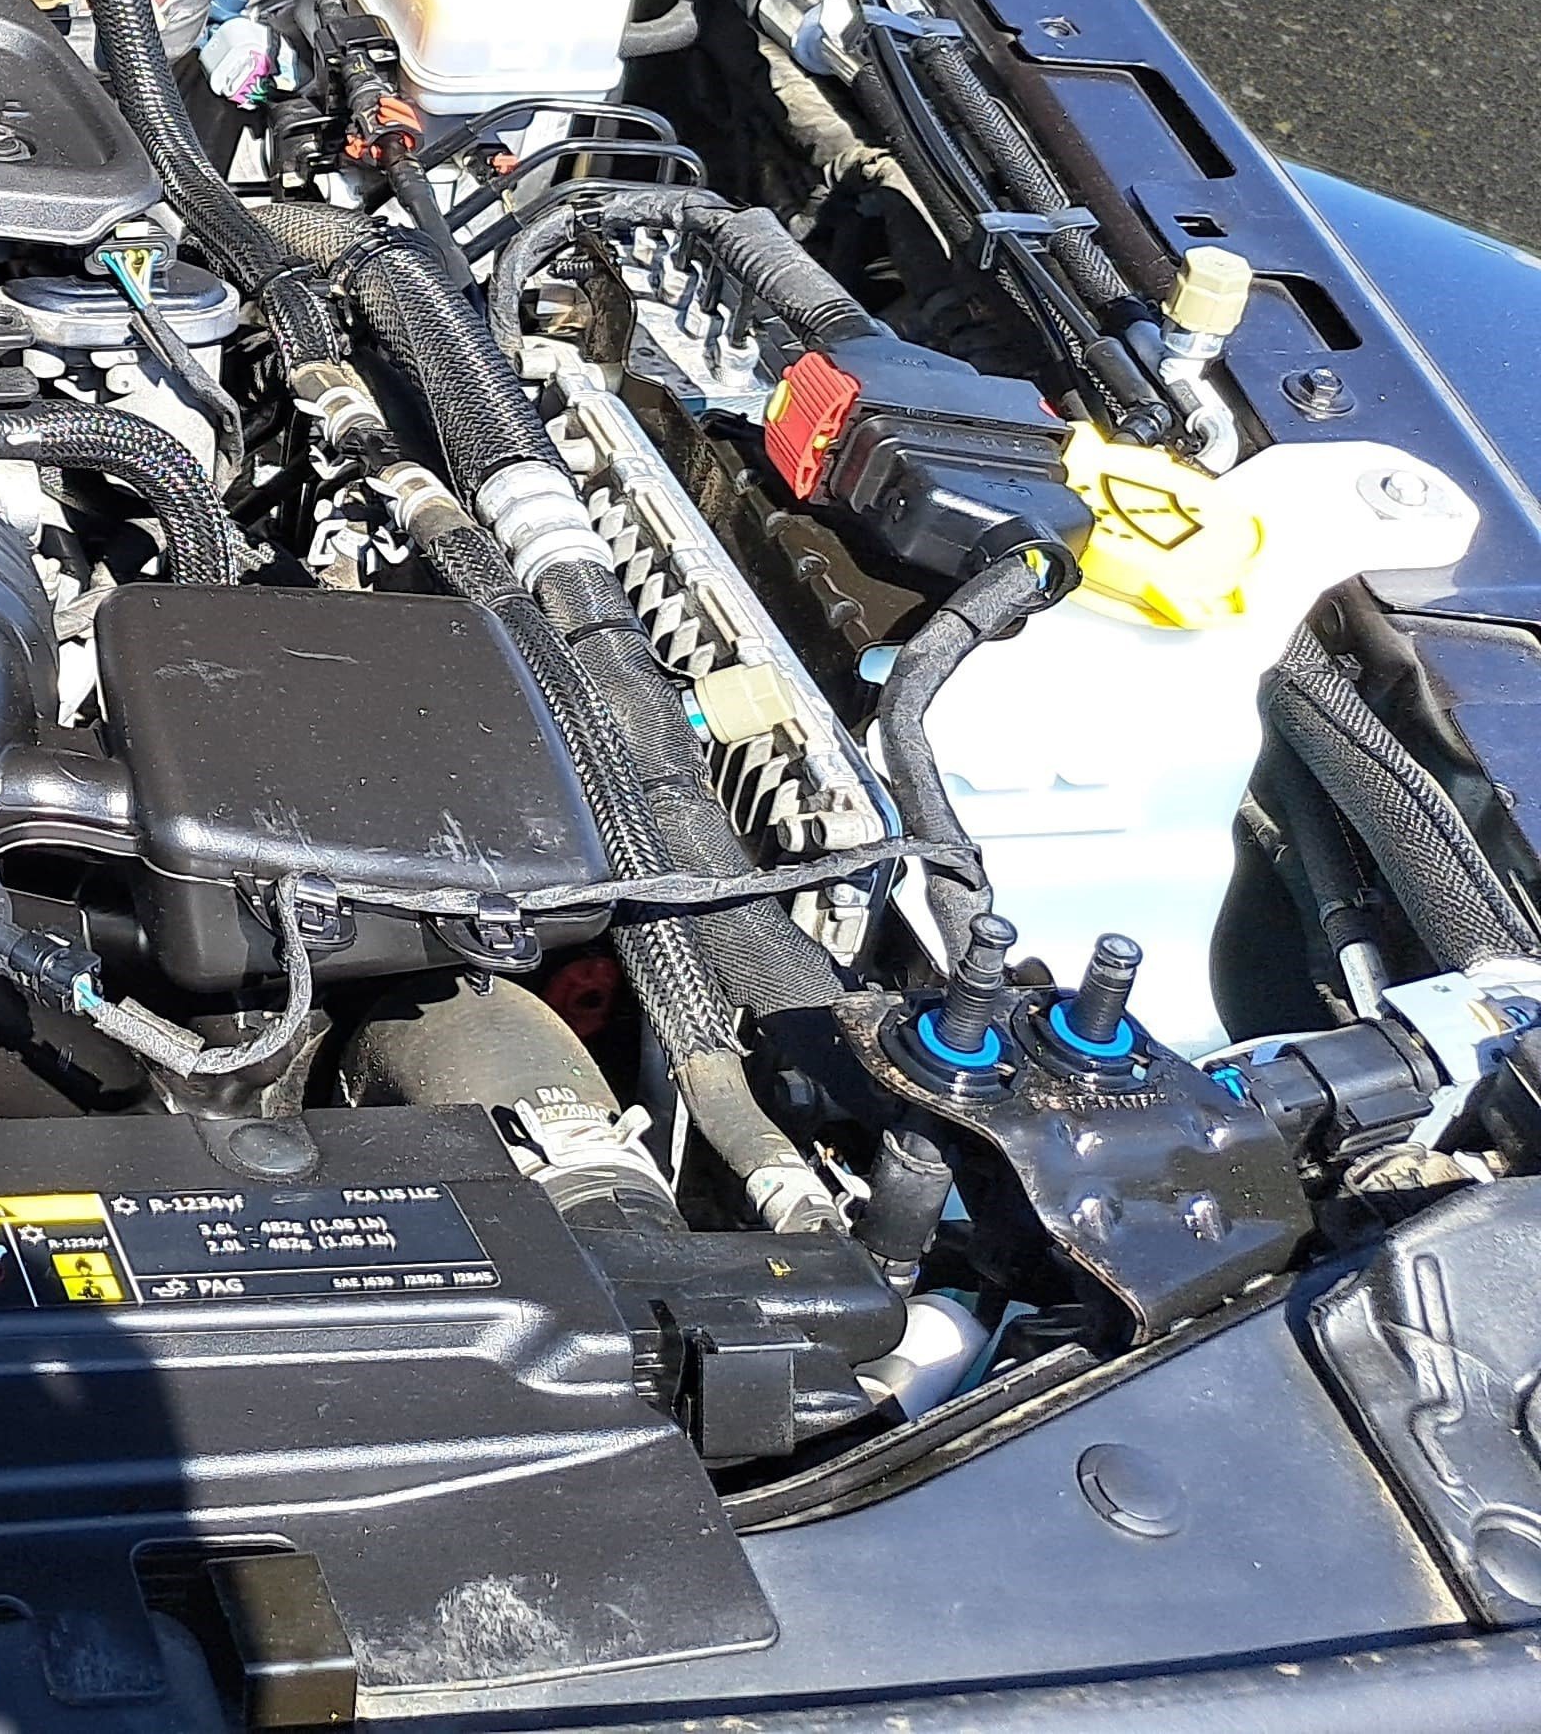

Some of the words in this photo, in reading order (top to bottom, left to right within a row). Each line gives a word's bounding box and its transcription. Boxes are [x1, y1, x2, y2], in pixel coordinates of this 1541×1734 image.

[535, 1086, 578, 1105] RAD
[148, 1194, 245, 1213] R-1234yf
[342, 1188, 380, 1204] FCA
[380, 1187, 407, 1201] US
[407, 1186, 443, 1201] LLC
[198, 1221, 238, 1236] 3.6L
[206, 1238, 246, 1253] 2.0L
[196, 1278, 245, 1295] PAG
[332, 1276, 361, 1289] SAE
